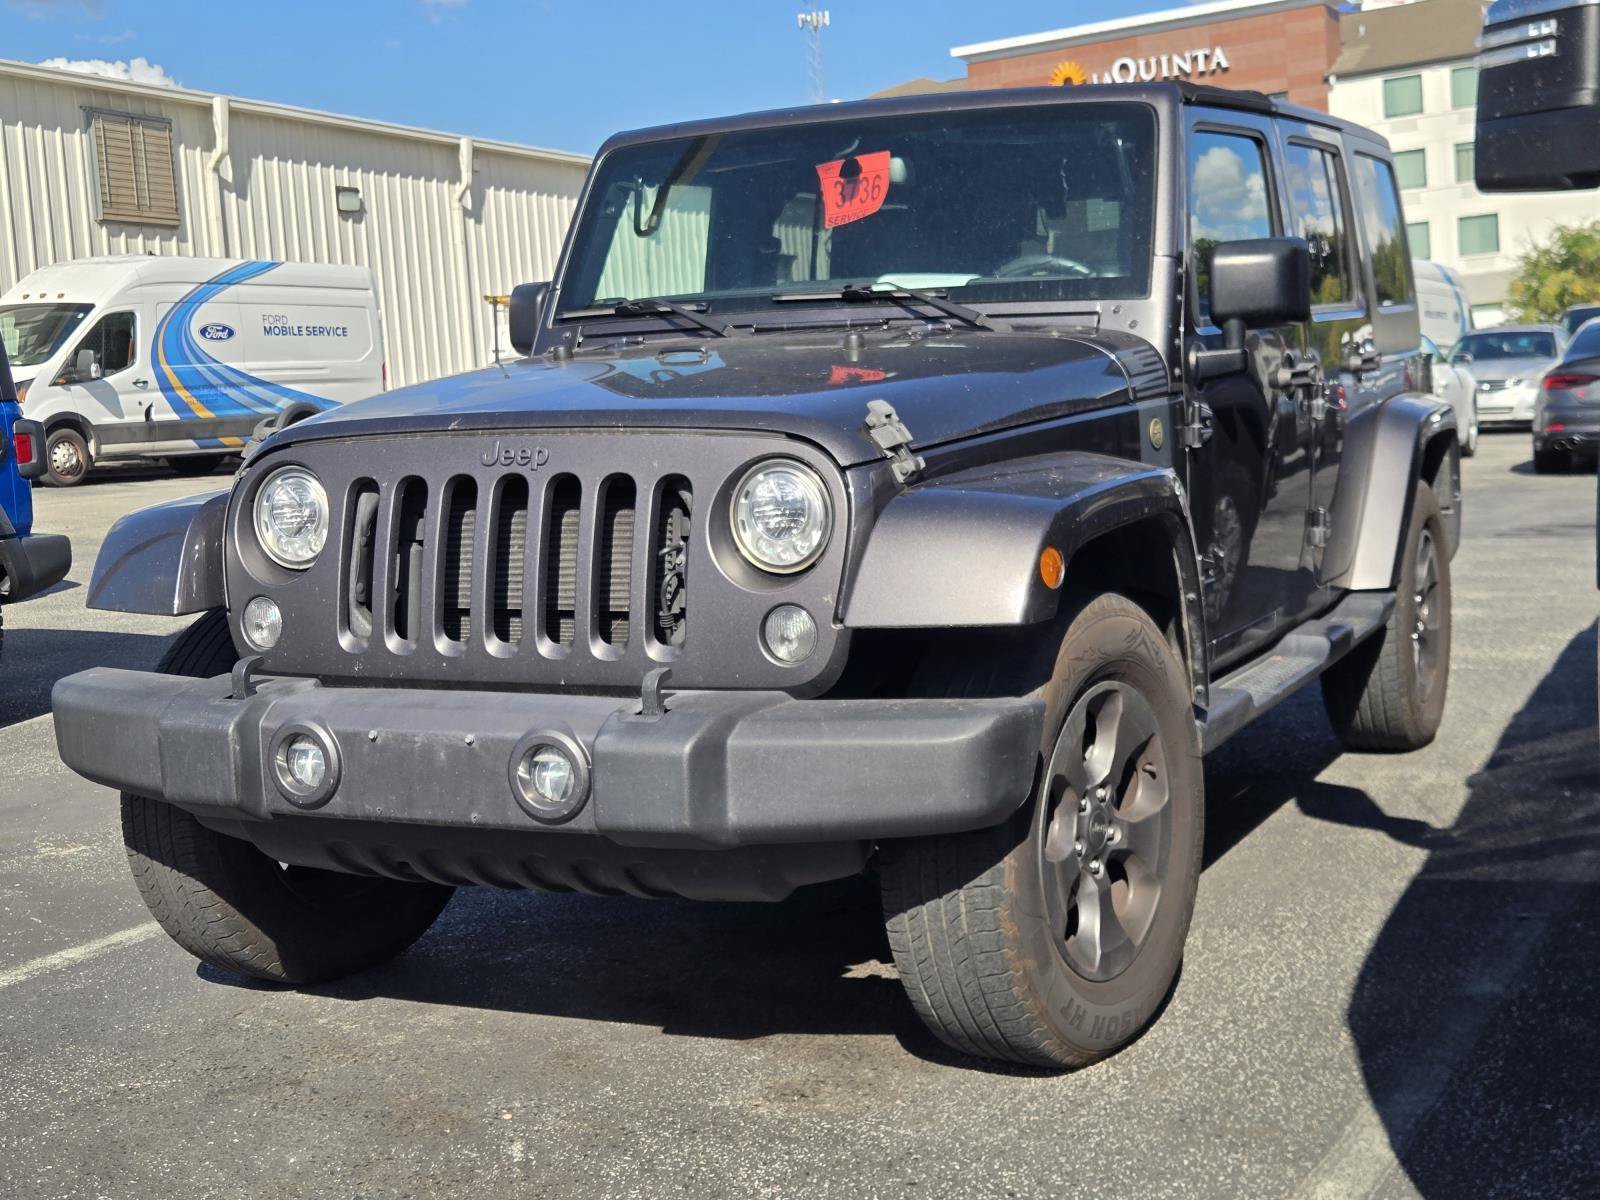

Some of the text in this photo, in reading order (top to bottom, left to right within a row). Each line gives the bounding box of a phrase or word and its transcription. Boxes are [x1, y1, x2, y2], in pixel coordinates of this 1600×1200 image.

[833, 174, 882, 209] 3736
[262, 314, 288, 325] FORD
[205, 325, 229, 340] Ford
[263, 326, 348, 337] MOBILE SERVICE
[480, 440, 550, 471] Jeep
